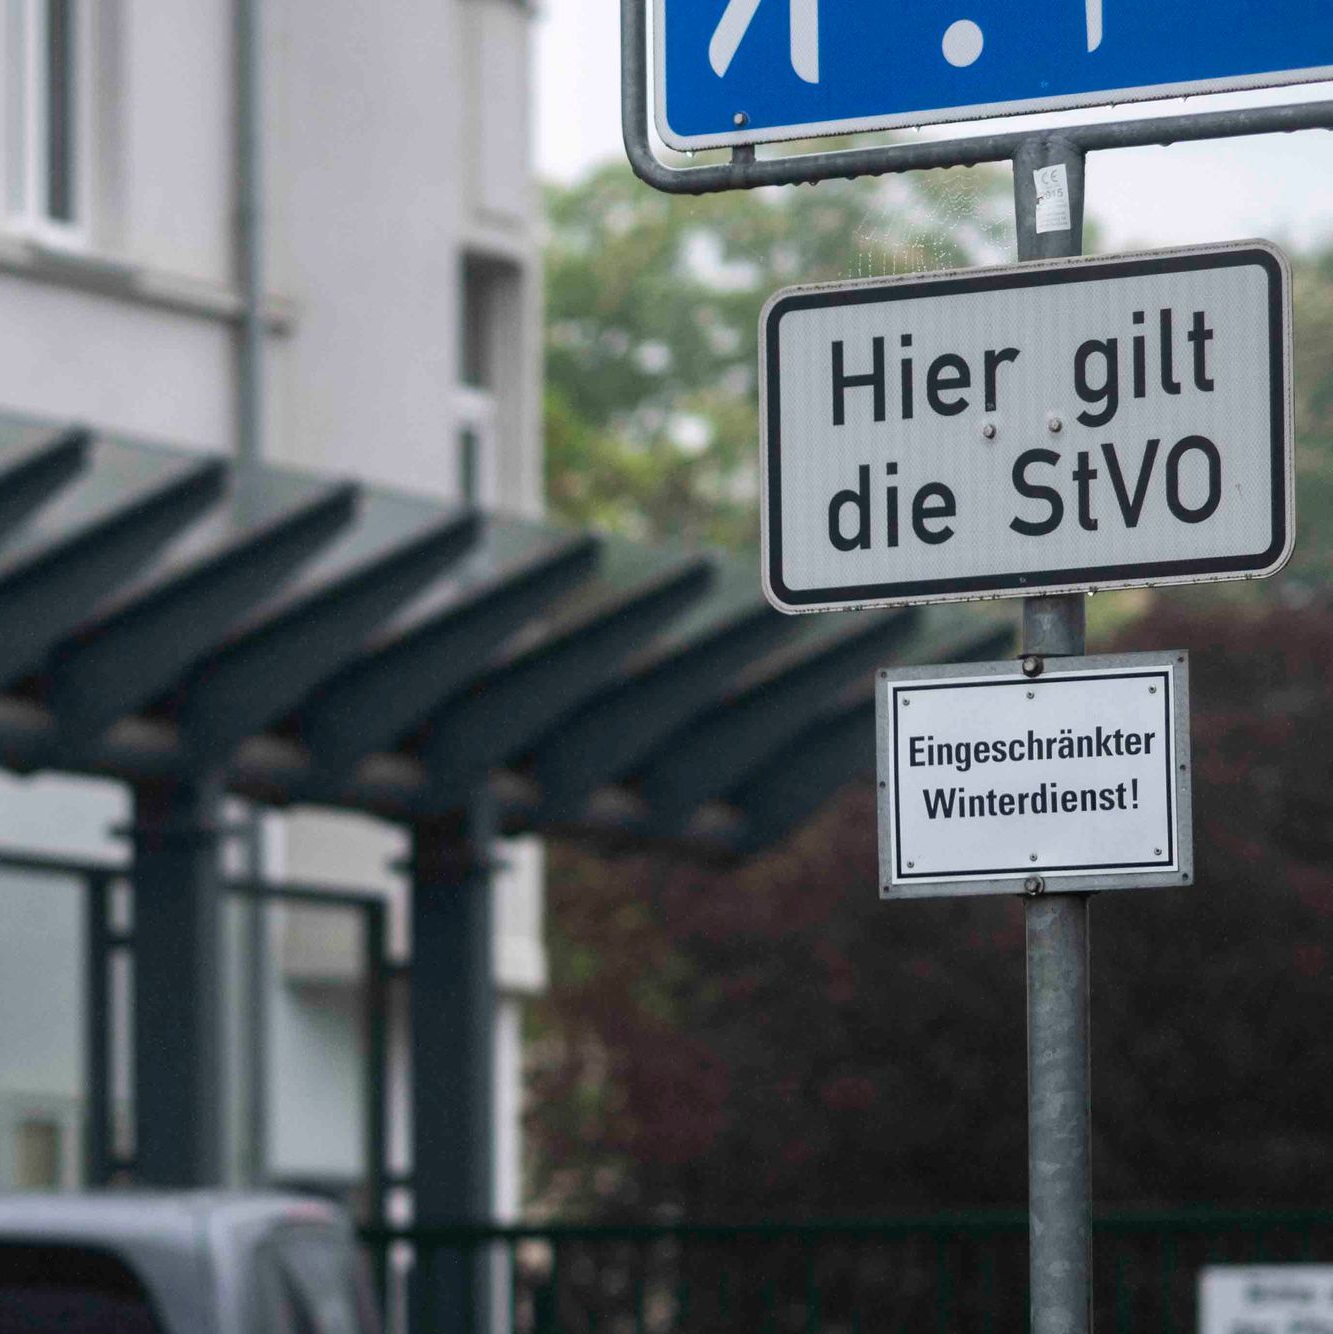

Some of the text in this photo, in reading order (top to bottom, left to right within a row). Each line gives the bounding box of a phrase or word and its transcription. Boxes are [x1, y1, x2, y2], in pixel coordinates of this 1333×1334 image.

[831, 307, 1215, 428] Hier gilt
[828, 434, 1222, 552] die StVO
[909, 726, 1156, 772] Eingeschränkter
[922, 778, 1138, 820] Winterdienst!
